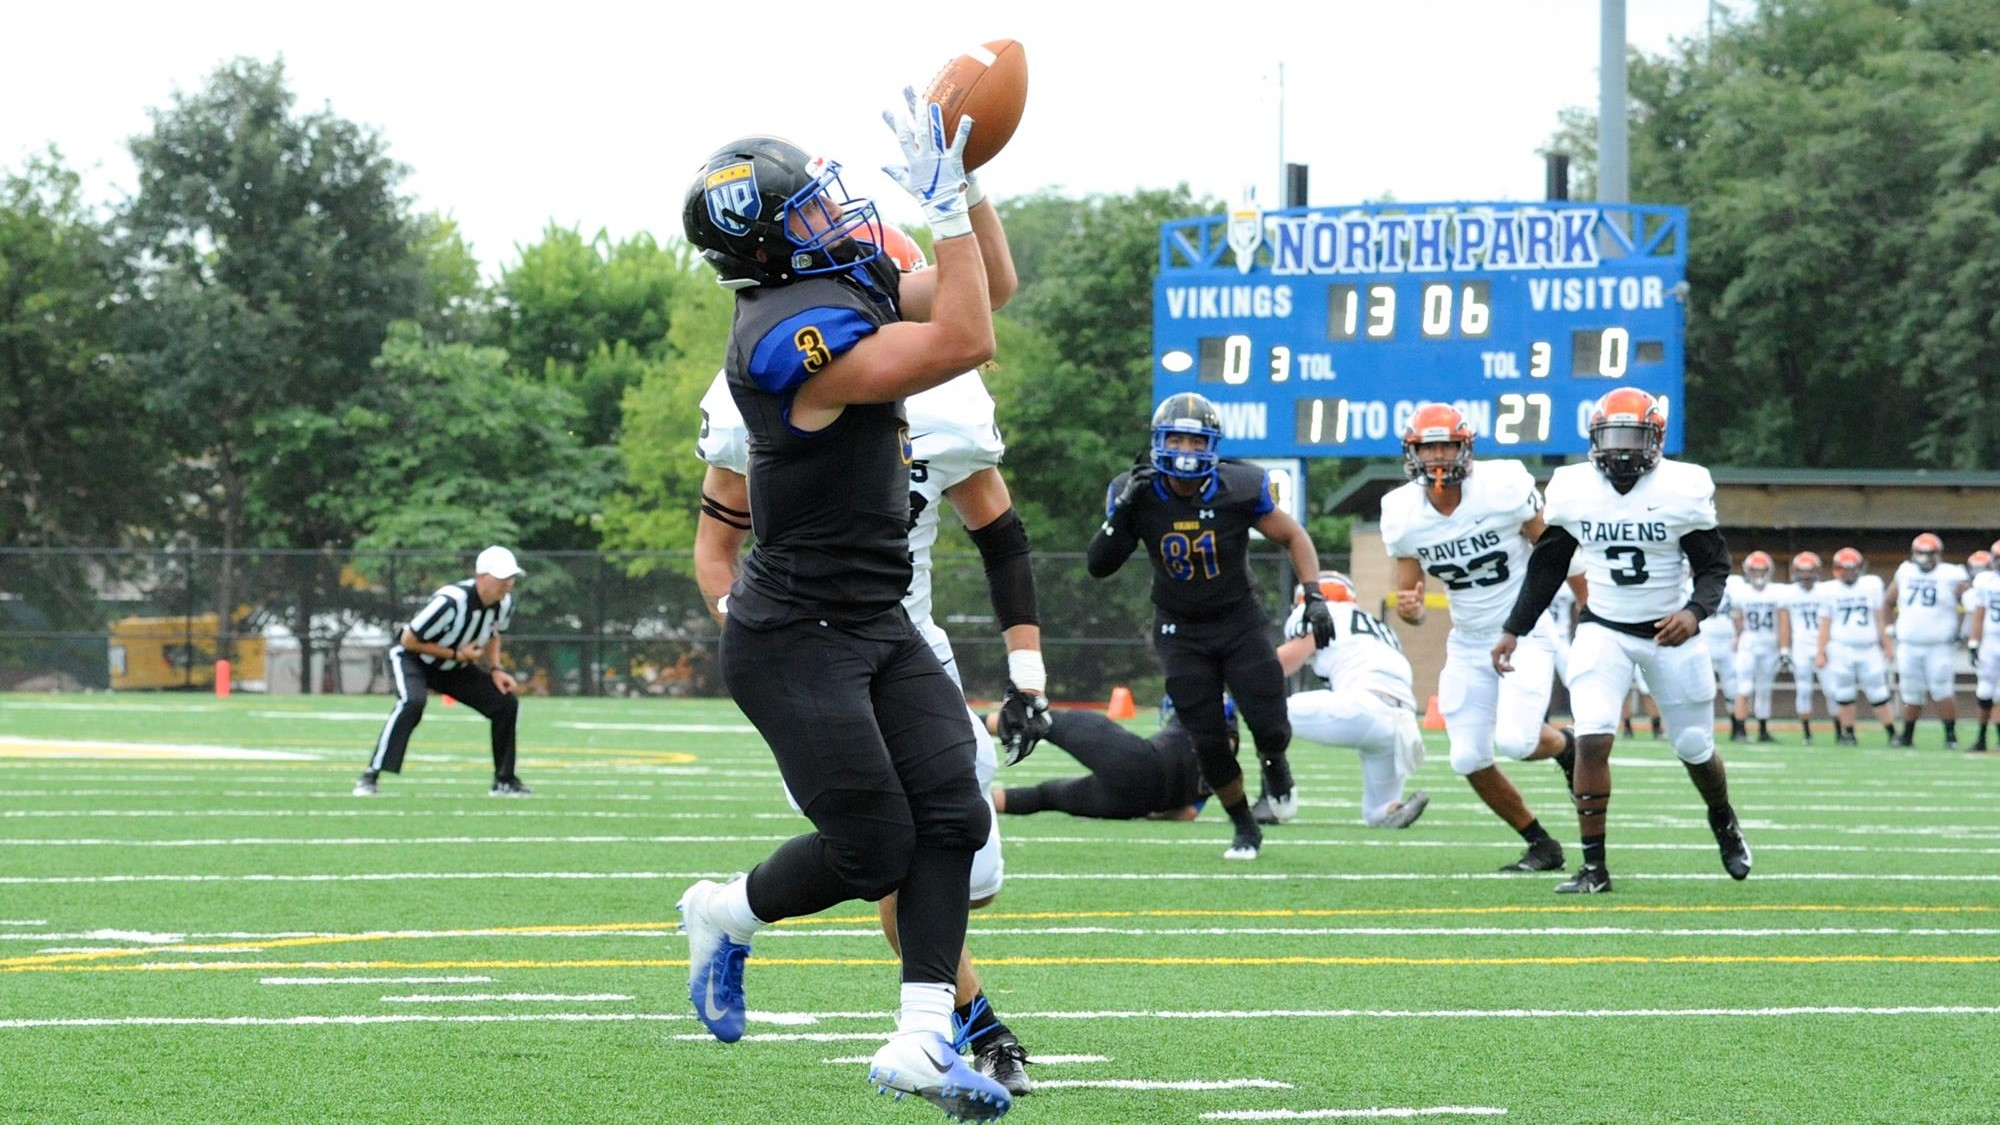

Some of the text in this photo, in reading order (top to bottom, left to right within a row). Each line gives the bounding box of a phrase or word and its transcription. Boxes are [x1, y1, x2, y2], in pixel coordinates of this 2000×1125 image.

[710, 181, 754, 230] NP
[1271, 209, 1601, 275] NORTH PARK
[1166, 285, 1293, 319] VIKINGS
[1344, 284, 1490, 336] 13 06
[1528, 276, 1664, 311] VISITOR
[794, 325, 832, 373] 3
[1223, 335, 1337, 385] 0 3 TOL
[1481, 327, 1629, 379] TOL 3 0
[1212, 402, 1267, 439] WN
[1310, 399, 1348, 443] 11
[1348, 402, 1388, 440] TO
[1494, 393, 1552, 444] 27
[1417, 530, 1500, 561] RAVENS
[1580, 521, 1667, 542] RAVENS
[1160, 530, 1220, 580] 81
[1427, 550, 1510, 590] 23
[1605, 545, 1650, 586] 3
[1838, 606, 1869, 626] 73
[1906, 585, 1937, 607] 79
